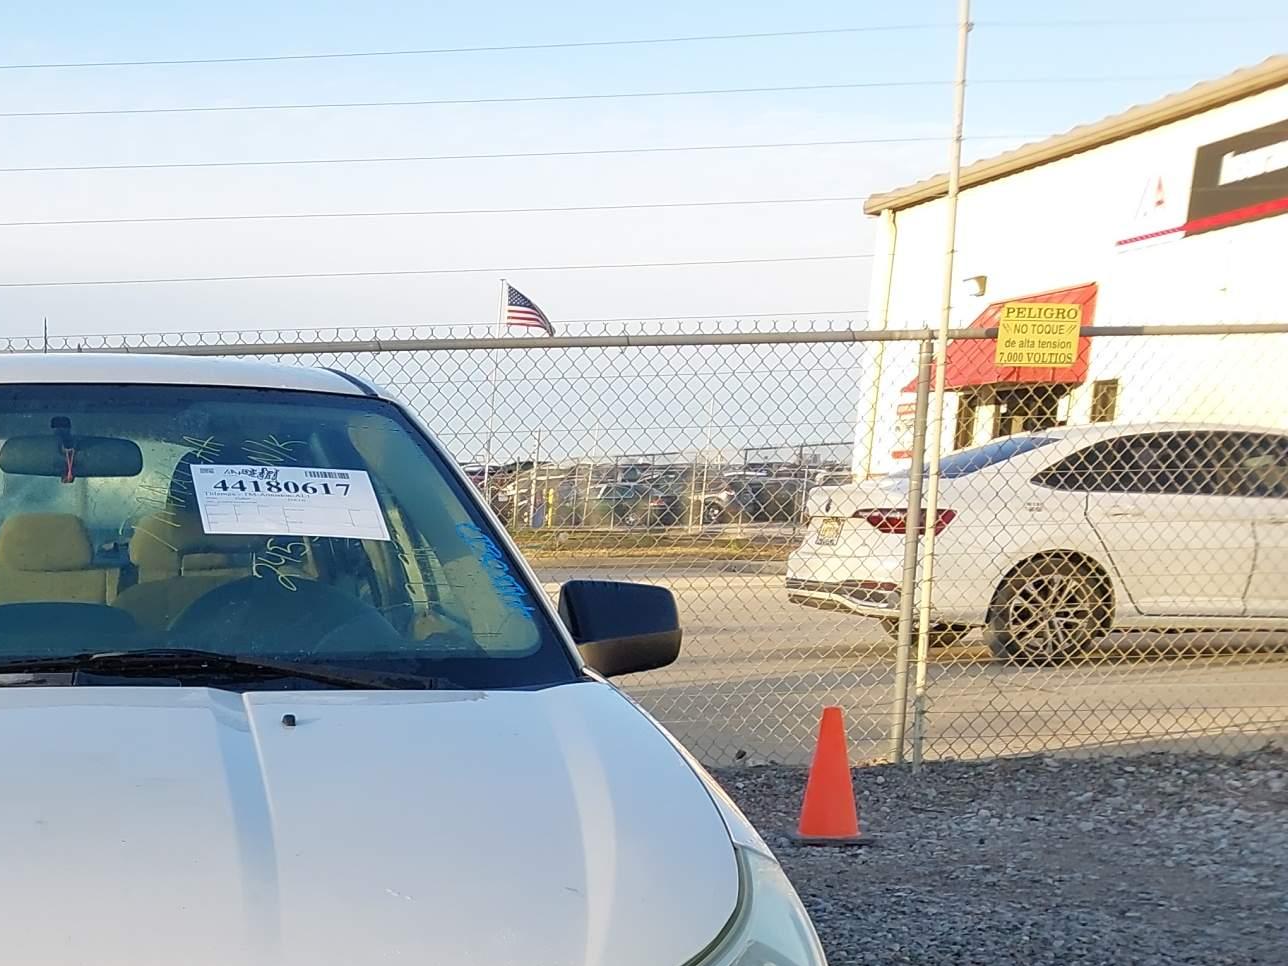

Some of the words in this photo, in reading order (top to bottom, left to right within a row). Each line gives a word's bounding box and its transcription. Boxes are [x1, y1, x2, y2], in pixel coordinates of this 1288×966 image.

[1005, 307, 1079, 320] PELIGRO
[1013, 323, 1029, 335] NO
[1031, 323, 1066, 335] TOQUE
[1004, 338, 1017, 349] de
[1018, 338, 1036, 349] alta
[1037, 339, 1072, 350] tension
[1025, 352, 1073, 364] VOLTIOS
[213, 479, 350, 497] 44180617
